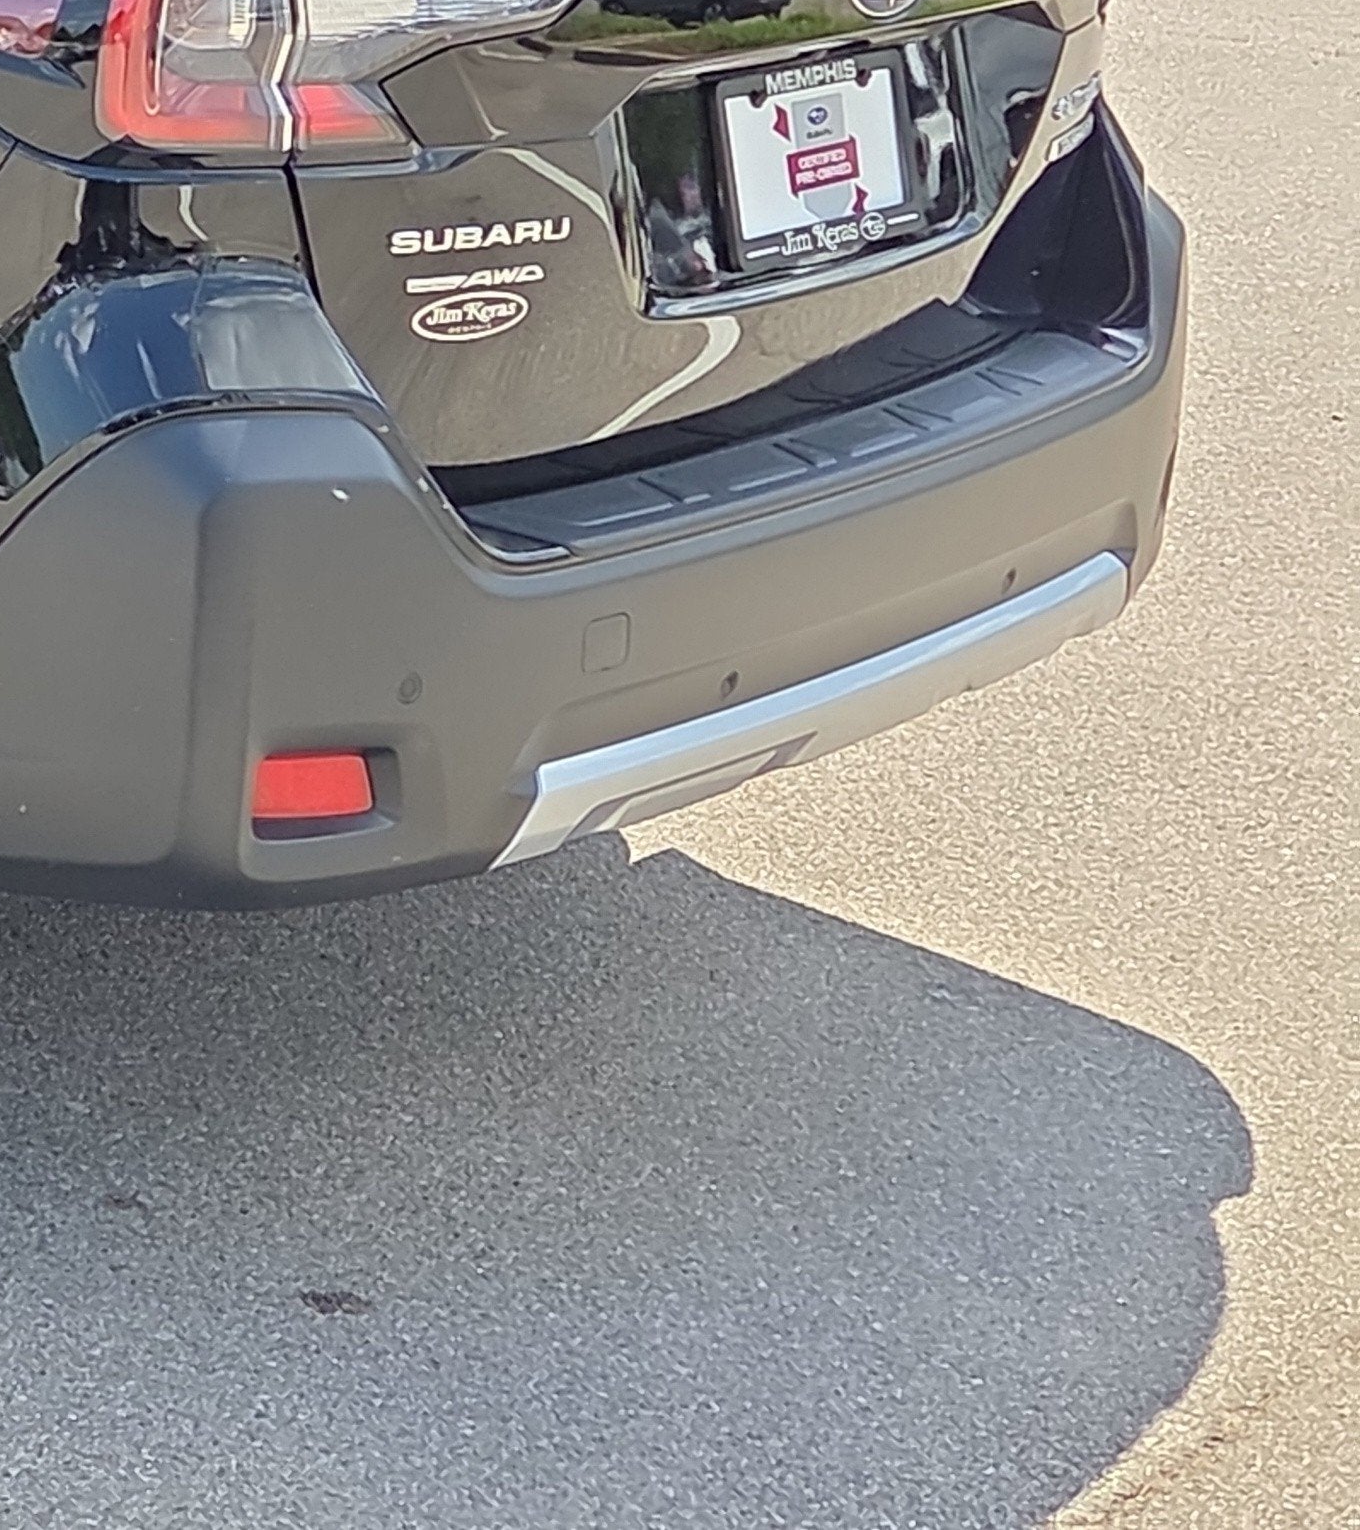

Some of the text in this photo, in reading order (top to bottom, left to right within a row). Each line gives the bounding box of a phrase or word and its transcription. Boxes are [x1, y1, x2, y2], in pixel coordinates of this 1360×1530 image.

[765, 58, 857, 95] MEMPHIS
[389, 216, 572, 255] SUBARU
[782, 221, 860, 256] Jim Keras
[460, 264, 546, 289] AWD
[426, 300, 518, 326] Jim Keras
